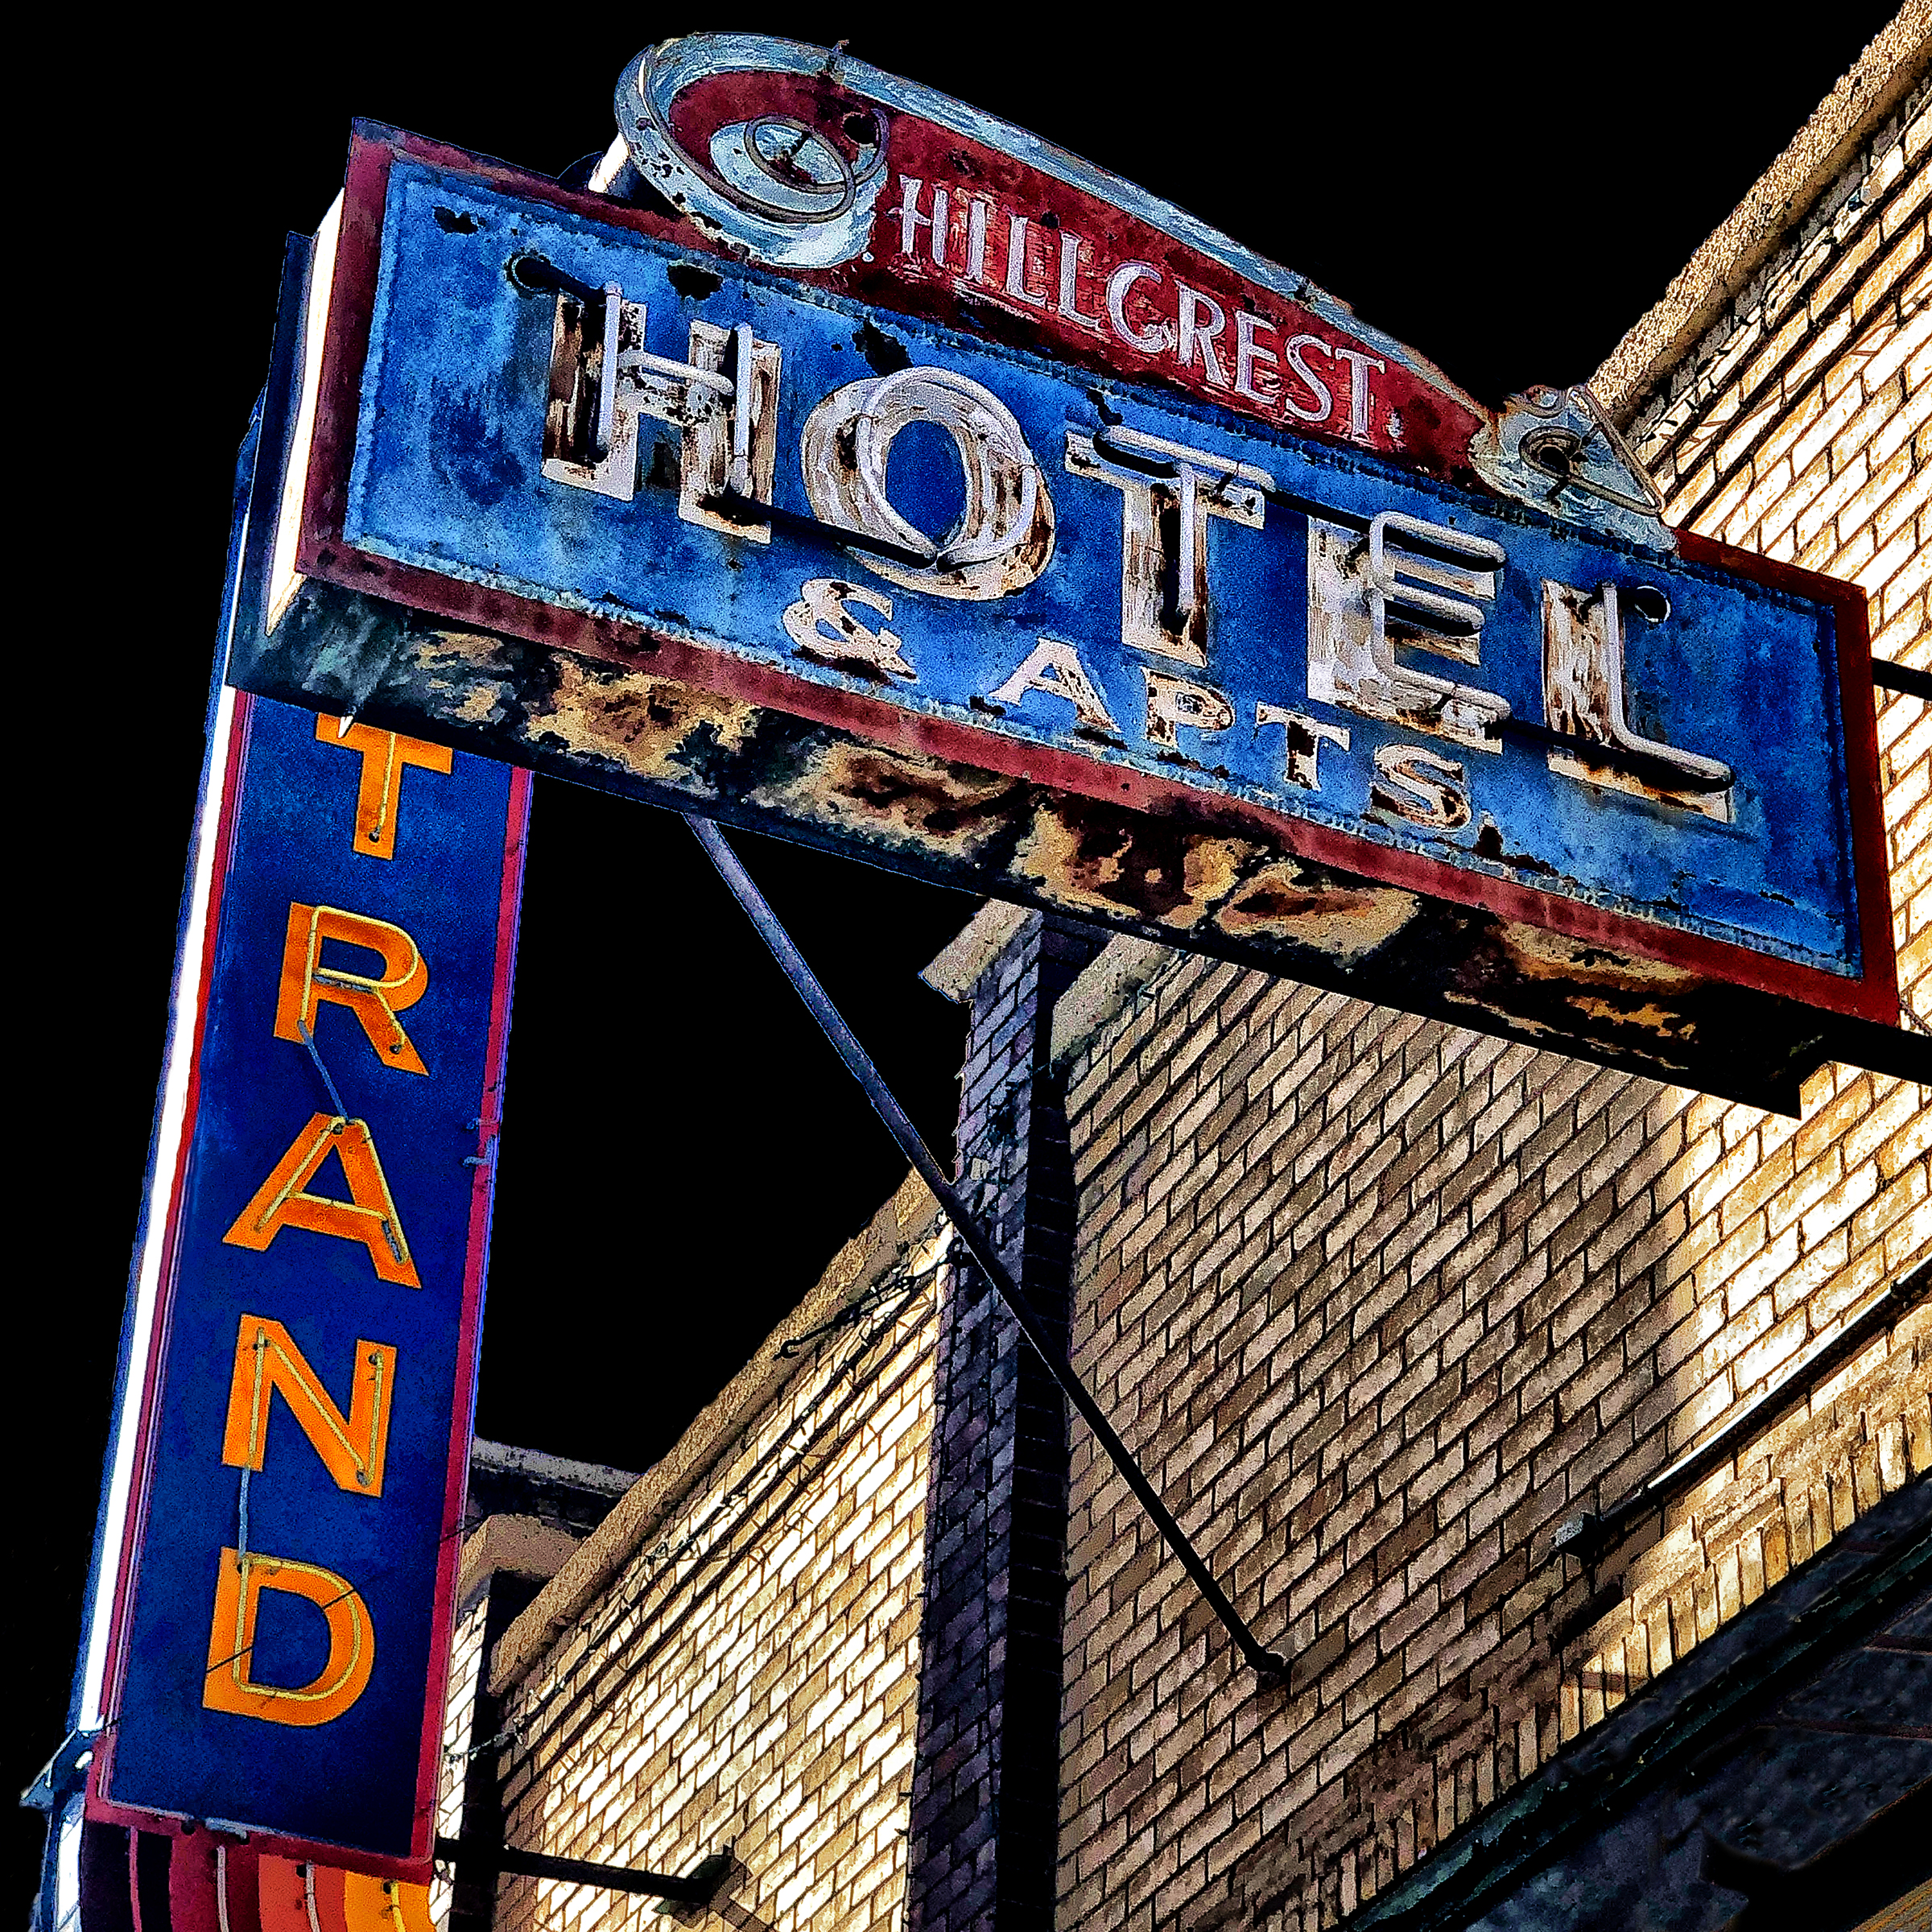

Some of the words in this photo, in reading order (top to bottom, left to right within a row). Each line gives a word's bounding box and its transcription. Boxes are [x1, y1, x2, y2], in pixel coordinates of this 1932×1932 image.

[888, 175, 1385, 443] HILLCREST
[542, 282, 1735, 822] HOTEL
[782, 577, 916, 683] &
[990, 636, 1472, 832] APTS
[202, 712, 453, 1727] TRAND
